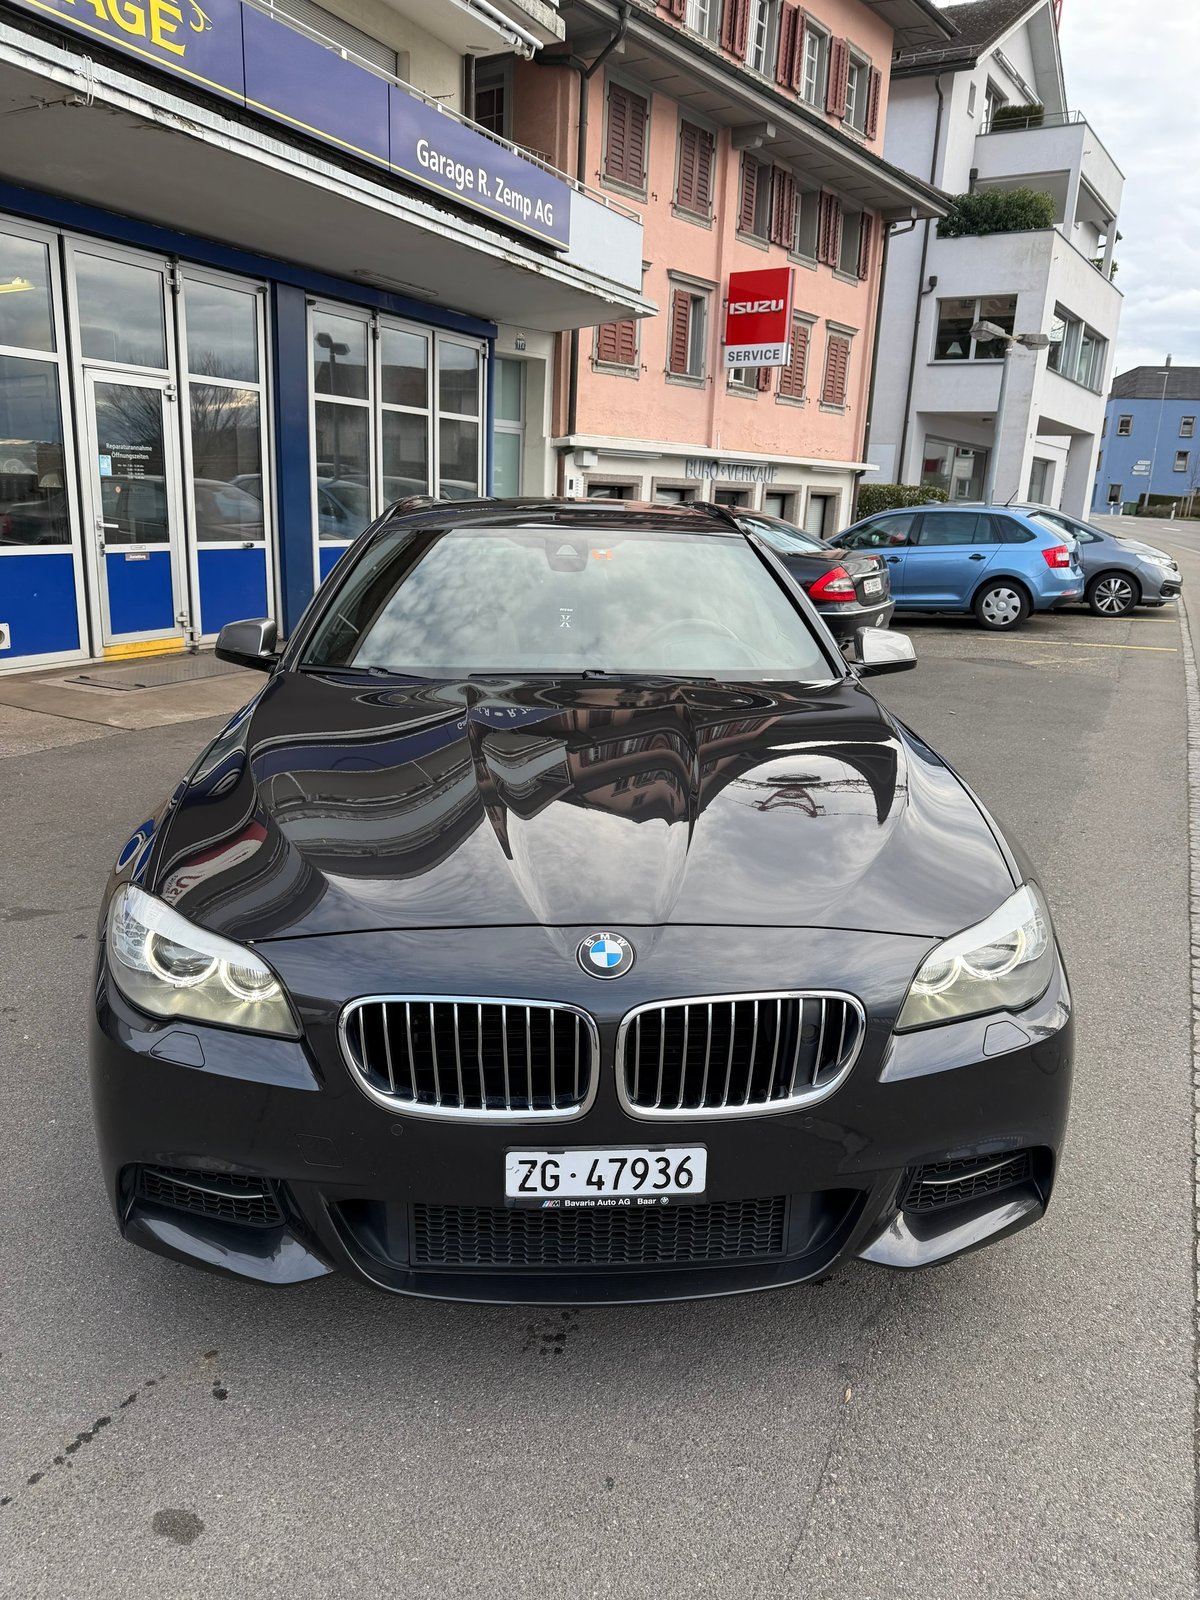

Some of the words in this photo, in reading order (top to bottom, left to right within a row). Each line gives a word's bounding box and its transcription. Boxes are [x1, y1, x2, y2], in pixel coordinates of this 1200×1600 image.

[416, 139, 474, 191] Garage
[478, 168, 491, 198] R.
[495, 177, 532, 221] Zemp
[534, 199, 553, 227] AG
[729, 299, 784, 315] ISUZU
[728, 349, 780, 362] SERVICE
[105, 443, 153, 452] Reparaturannahme
[111, 451, 150, 460] Öffnungszeiten
[728, 464, 779, 484] VERKAUF
[584, 933, 628, 947] BMW
[518, 1159, 560, 1192] ZG
[586, 1155, 693, 1191] 47936
[564, 1199, 595, 1207] Bavaria
[618, 1198, 631, 1206] AG
[637, 1197, 656, 1205] Baar
